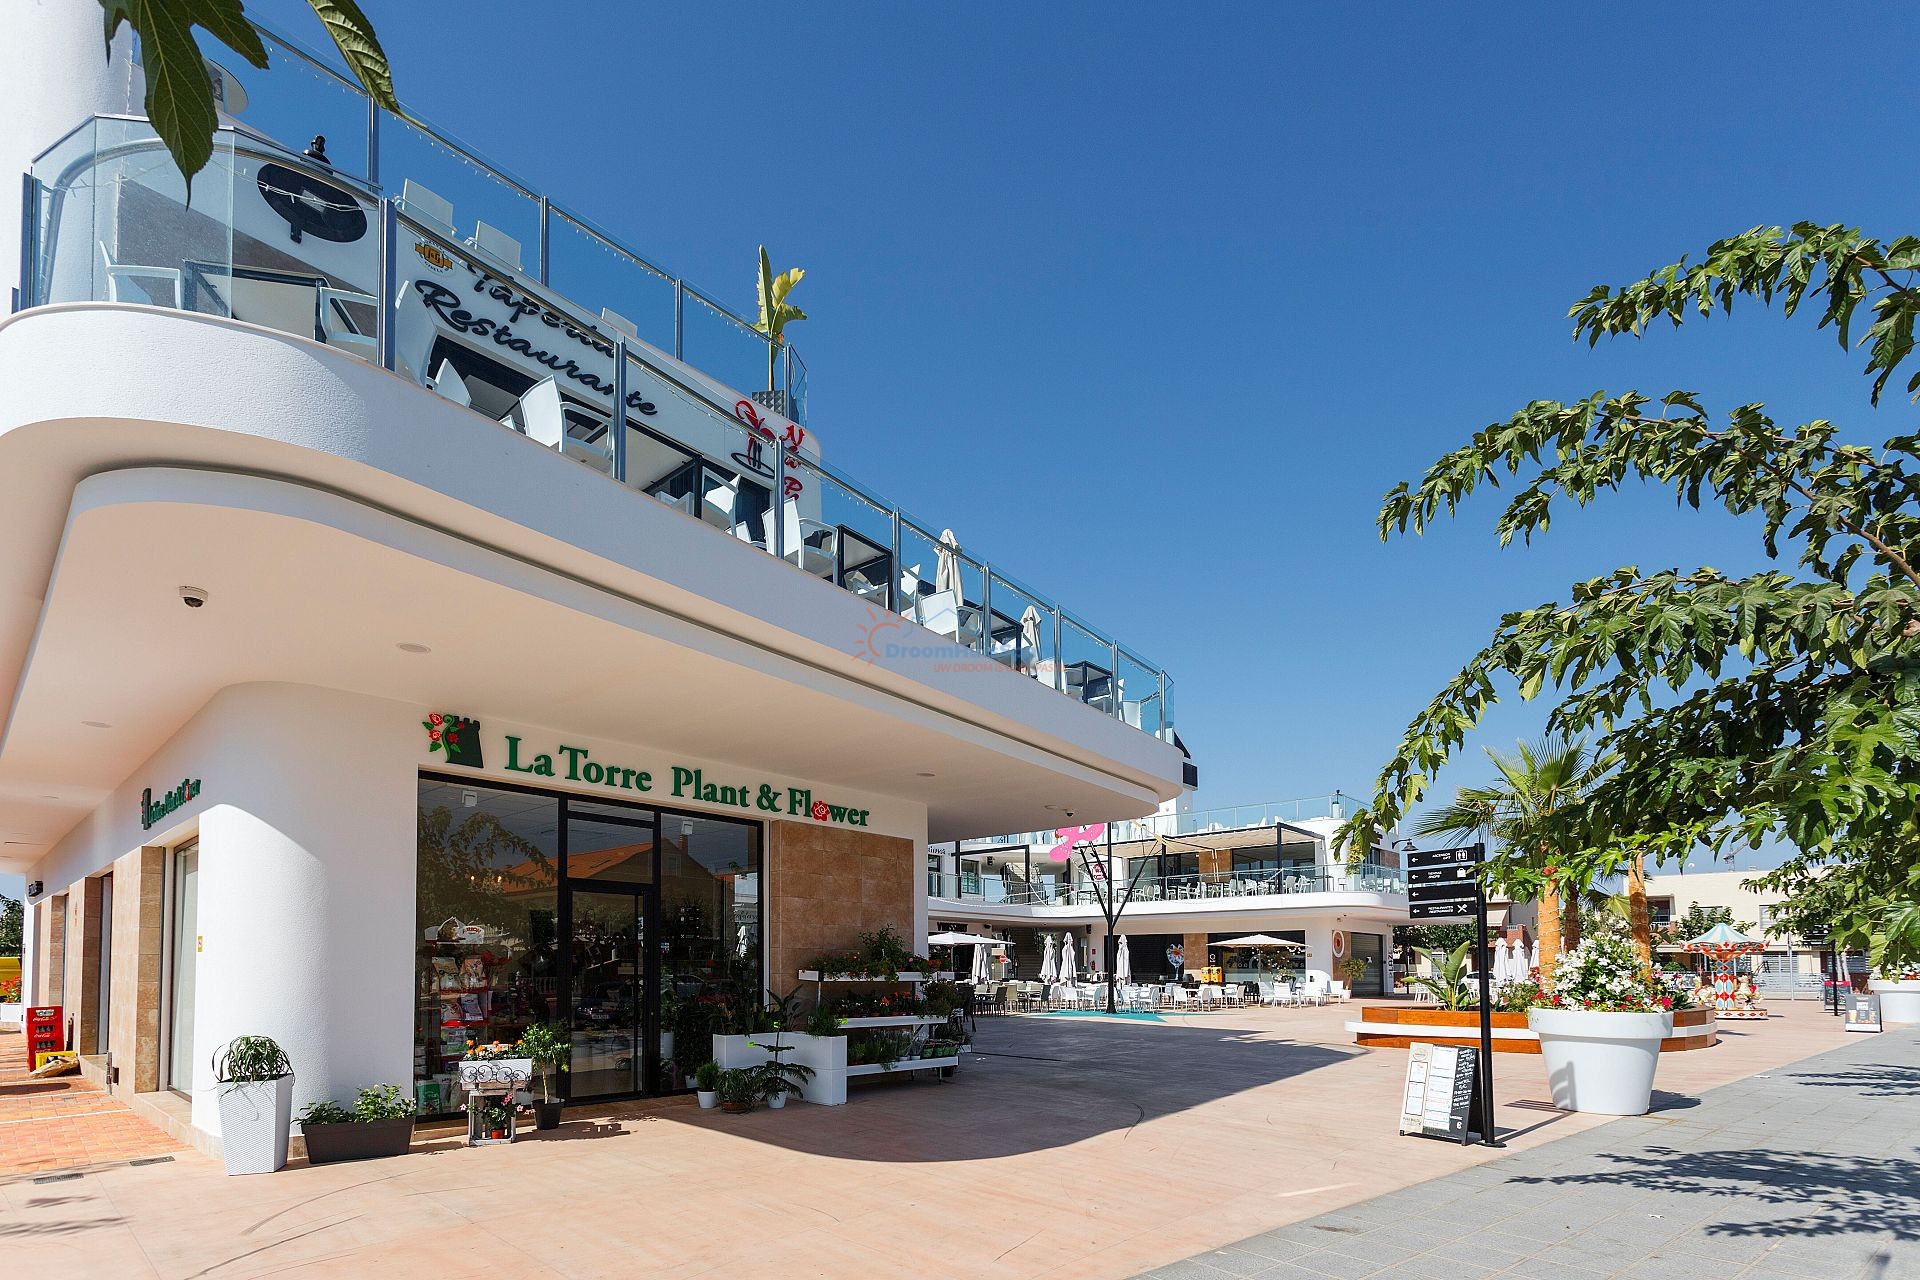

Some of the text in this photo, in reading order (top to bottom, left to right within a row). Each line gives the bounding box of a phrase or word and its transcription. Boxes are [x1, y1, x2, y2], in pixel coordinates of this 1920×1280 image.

[504, 735, 556, 777] La
[558, 744, 652, 792] Torre
[671, 766, 750, 807] Plant
[756, 783, 782, 812] &
